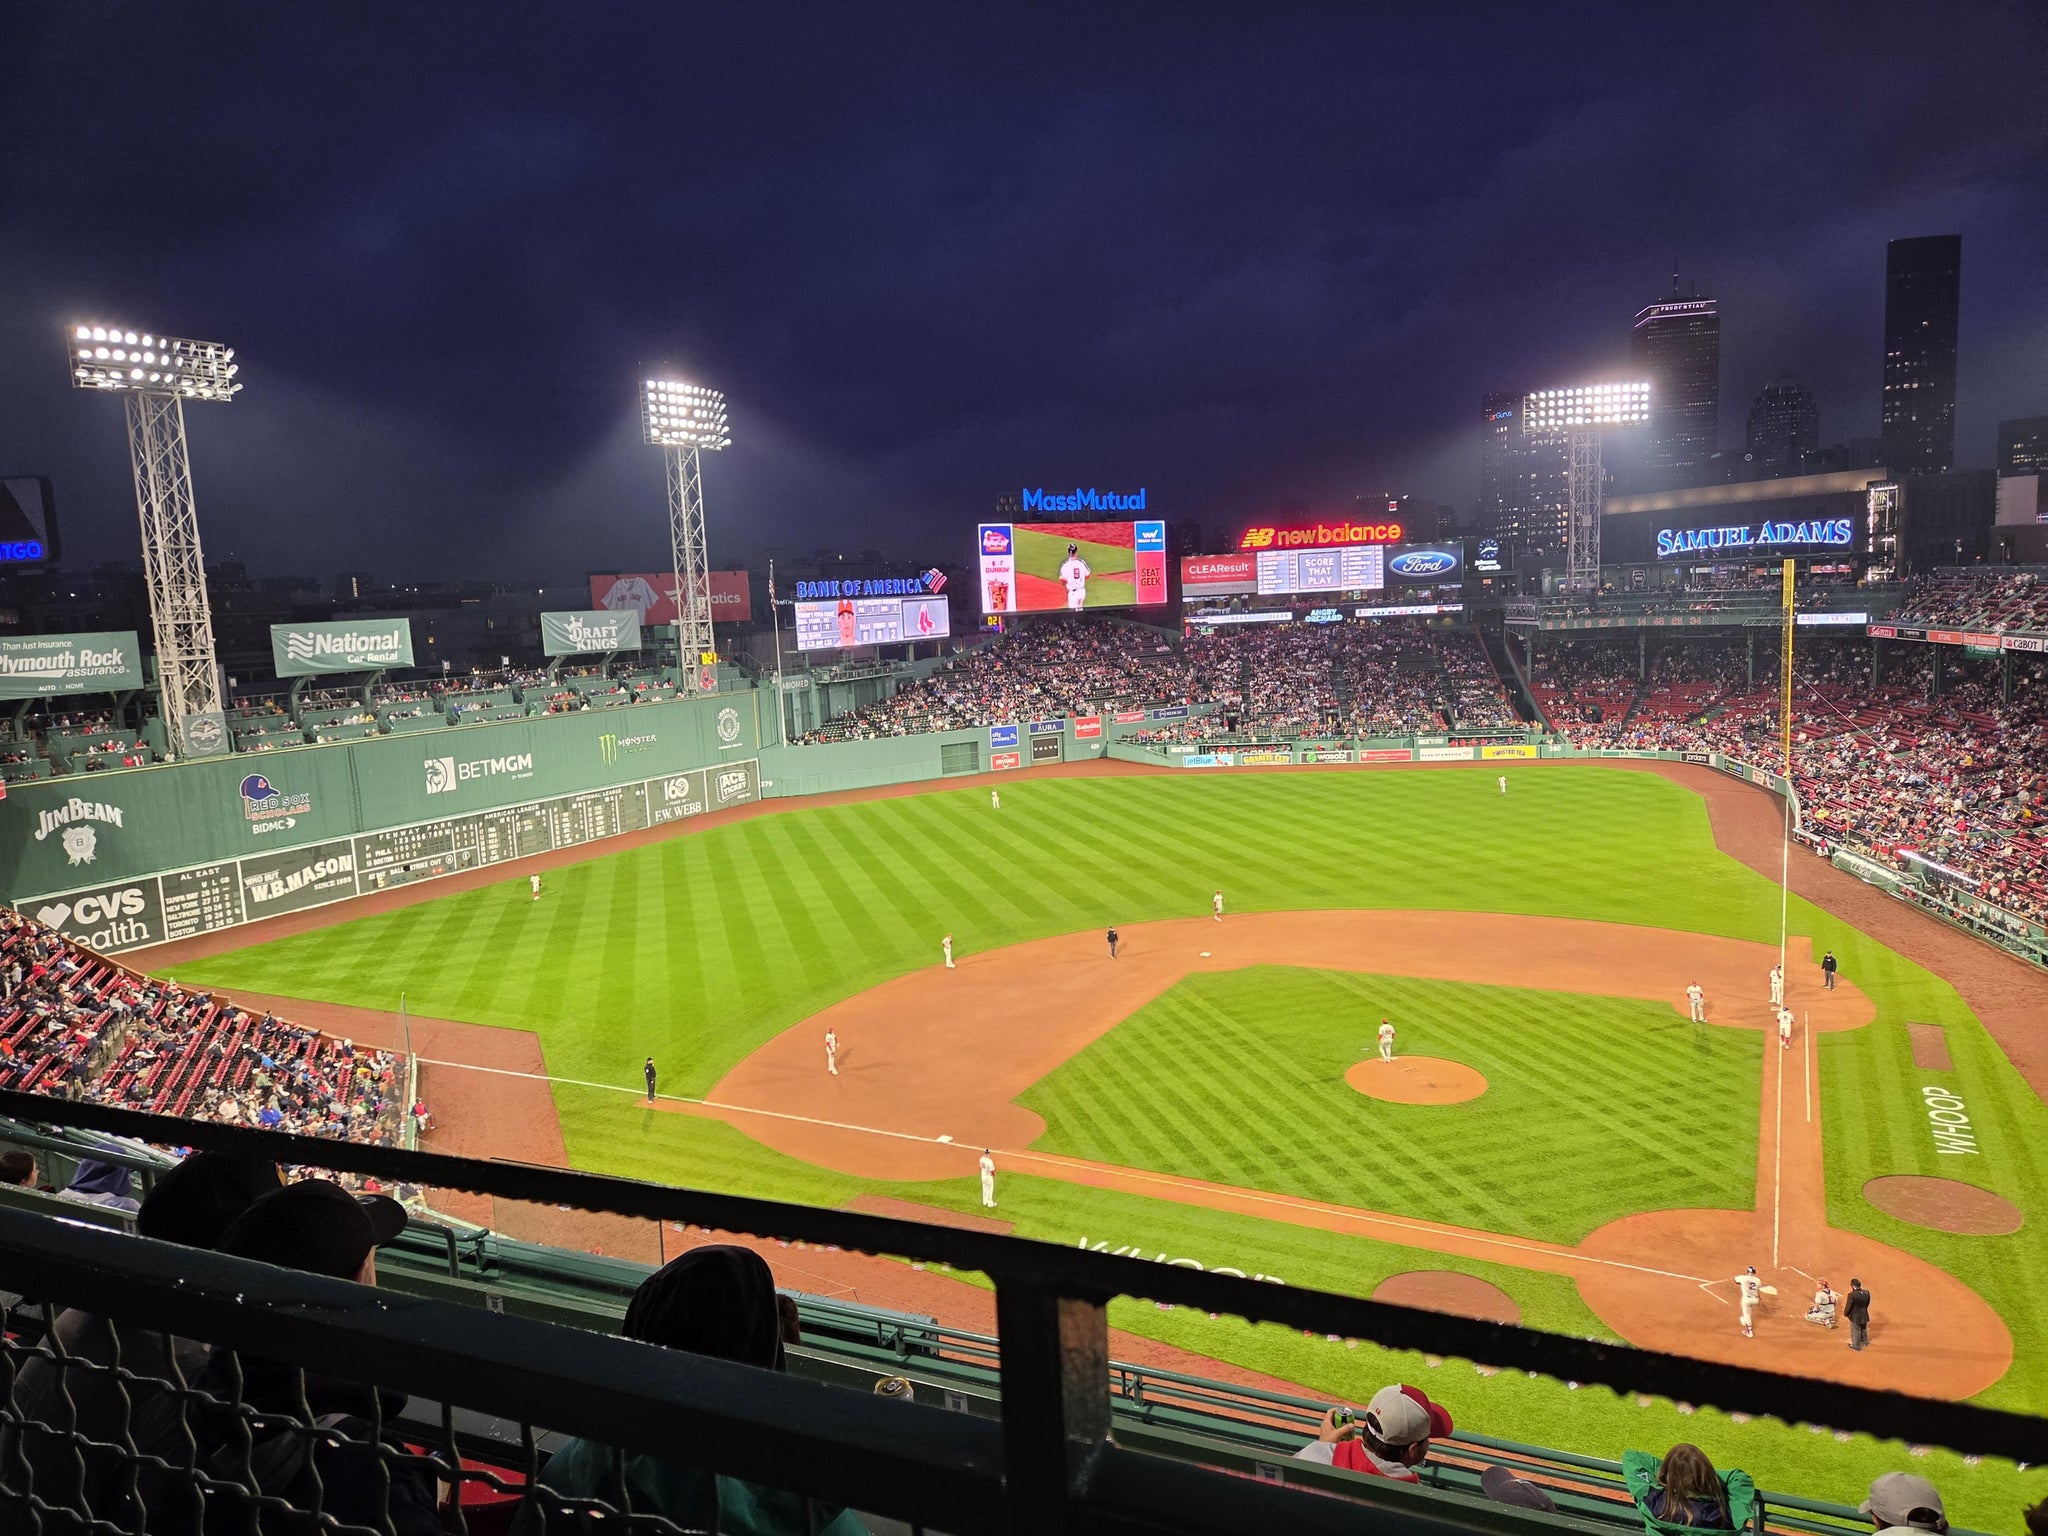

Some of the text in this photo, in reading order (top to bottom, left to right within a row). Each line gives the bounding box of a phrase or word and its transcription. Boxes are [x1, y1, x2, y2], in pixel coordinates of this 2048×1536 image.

[1022, 487, 1146, 511] MassMutual
[1657, 519, 1852, 557] SAMUEL ADAMS
[1189, 562, 1249, 575] CLEAResult
[1305, 557, 1335, 567] SCORE
[1403, 555, 1443, 572] Ford
[1141, 568, 1160, 577] SEAT
[1308, 567, 1332, 575] THAT
[796, 578, 923, 598] BANK OF AMERICA
[1141, 578, 1161, 586] GEEK
[1308, 577, 1332, 585] PLAY
[569, 626, 618, 642] DRAFT
[3, 642, 20, 650] Than
[22, 642, 37, 650] Just
[315, 630, 399, 655] National
[576, 638, 618, 651] KINGS
[80, 648, 123, 667] Rock
[347, 651, 398, 663] Car Rental
[67, 664, 126, 677] assurance
[1186, 757, 1212, 766] jetBlue
[1317, 752, 1347, 761] wasabi
[458, 753, 533, 781] BETMGM
[722, 772, 746, 787] ACE
[664, 778, 690, 800] 160
[723, 781, 747, 796] TICKET
[250, 793, 311, 812] RED SOX
[674, 801, 702, 817] WEBB
[34, 797, 124, 841] JIM BEAM
[252, 820, 286, 835] BIDMC
[379, 822, 453, 841] FENWAY PARK
[373, 855, 394, 866] BOSTON
[409, 862, 428, 871] STRIKE
[430, 858, 442, 866] OUT
[196, 867, 220, 878] EAST
[73, 888, 146, 925] CVS
[181, 901, 199, 910] YORK
[224, 893, 230, 901] 2
[168, 917, 199, 930] TORONTO
[61, 917, 150, 950] ealth
[169, 927, 196, 938] BOSTON
[1922, 1086, 1980, 1155] WHOOP
[1749, 1282, 1757, 1291] 2
